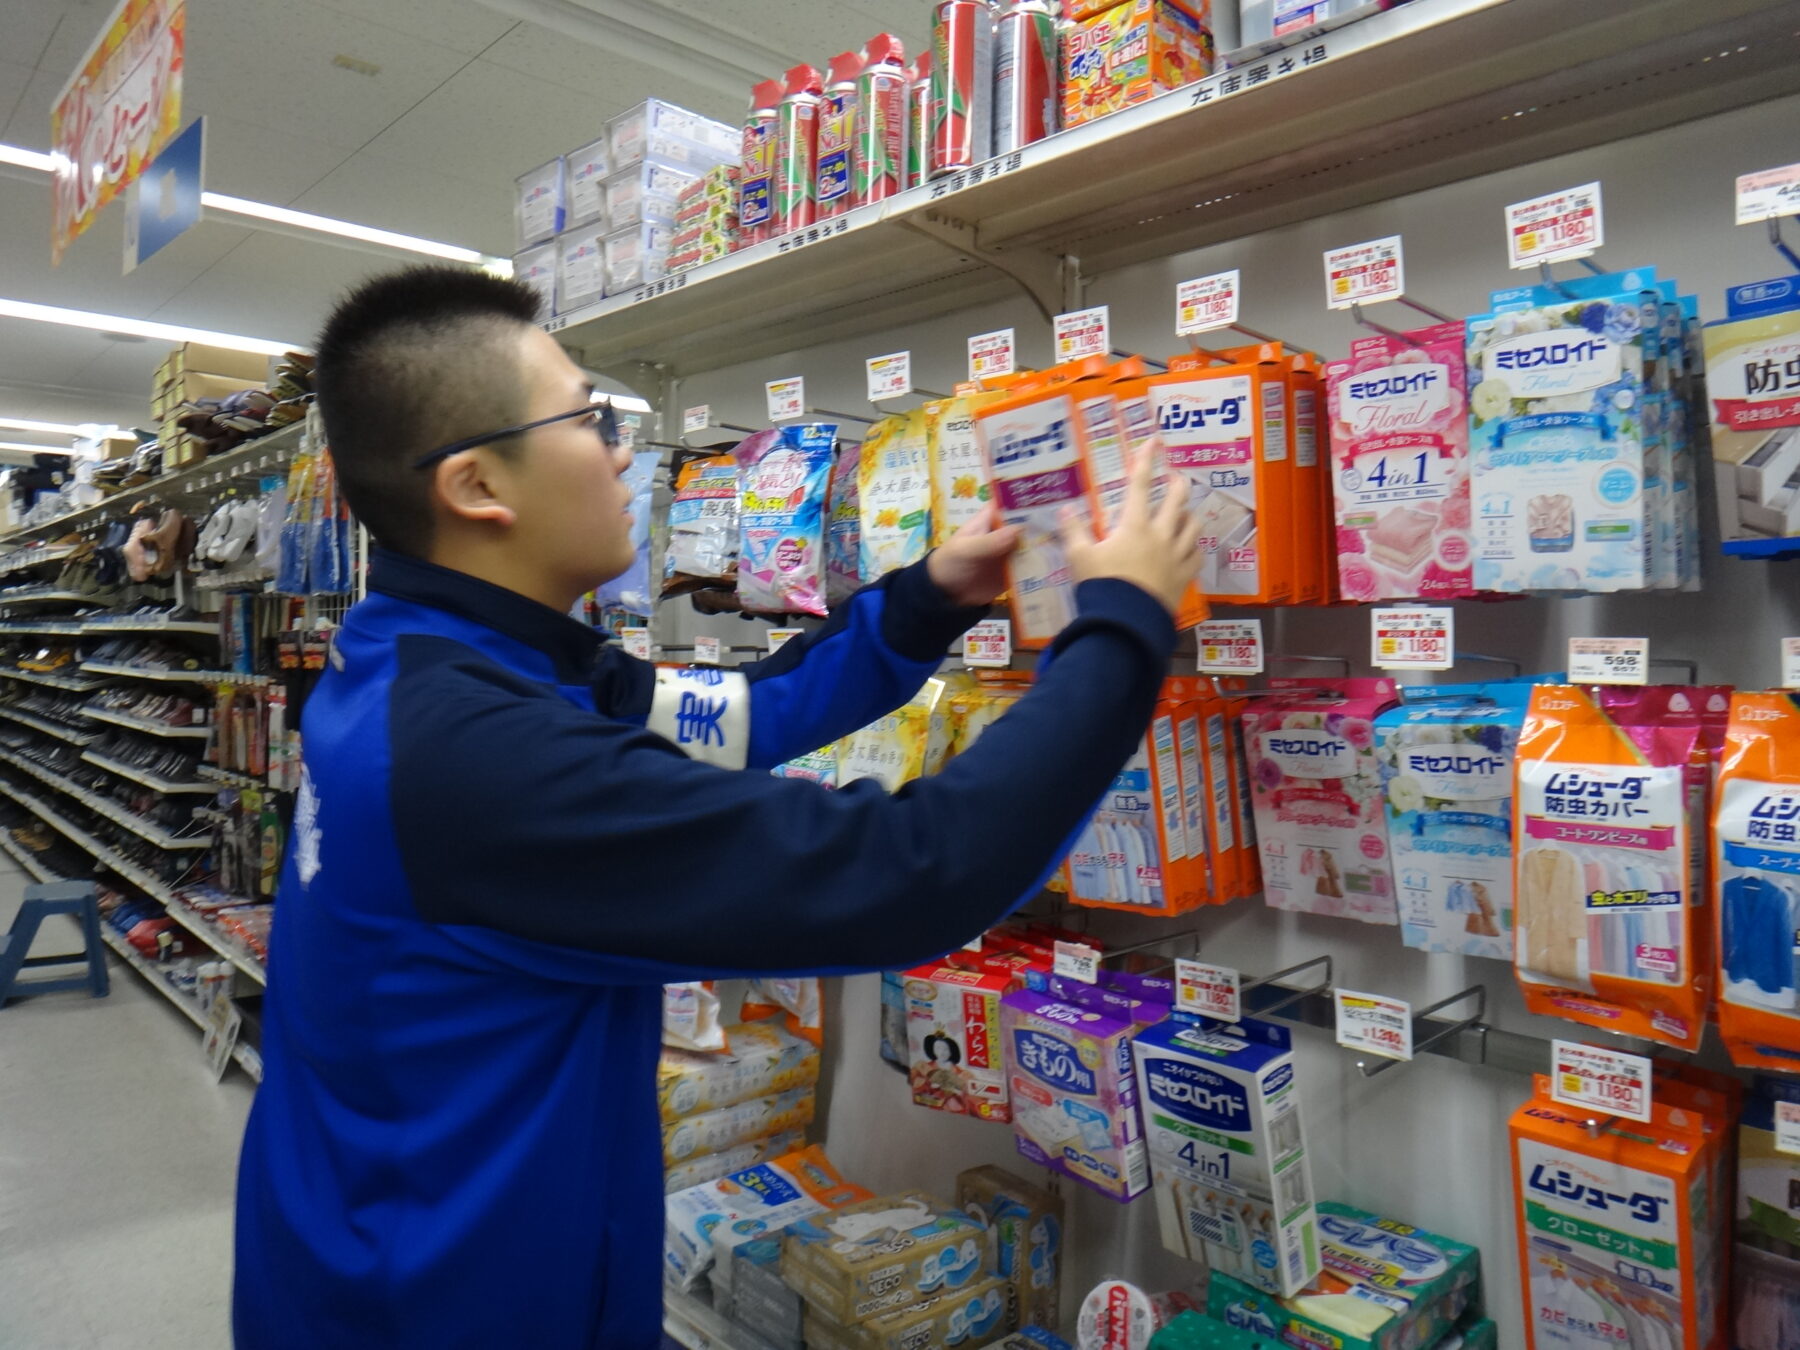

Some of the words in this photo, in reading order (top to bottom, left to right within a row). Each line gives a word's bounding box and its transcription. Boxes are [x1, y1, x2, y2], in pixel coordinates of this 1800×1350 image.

[1496, 338, 1608, 370] ミセスロイド
[1350, 371, 1438, 400] ミセスロイド
[1354, 400, 1429, 432] Floral
[1604, 655, 1638, 667] 598
[1269, 738, 1347, 757] ミセスロイド
[1409, 755, 1505, 774] ミセスロイド
[1544, 773, 1652, 800] ムシューダ
[1544, 795, 1650, 818] 防虫カバー
[966, 1018, 989, 1067] わらべ
[1149, 1072, 1246, 1118] ミセスロイド
[1529, 1163, 1669, 1223] ムシューダ
[1547, 1216, 1656, 1262] クローゼット用
[1539, 1305, 1628, 1341] カビからも守る
